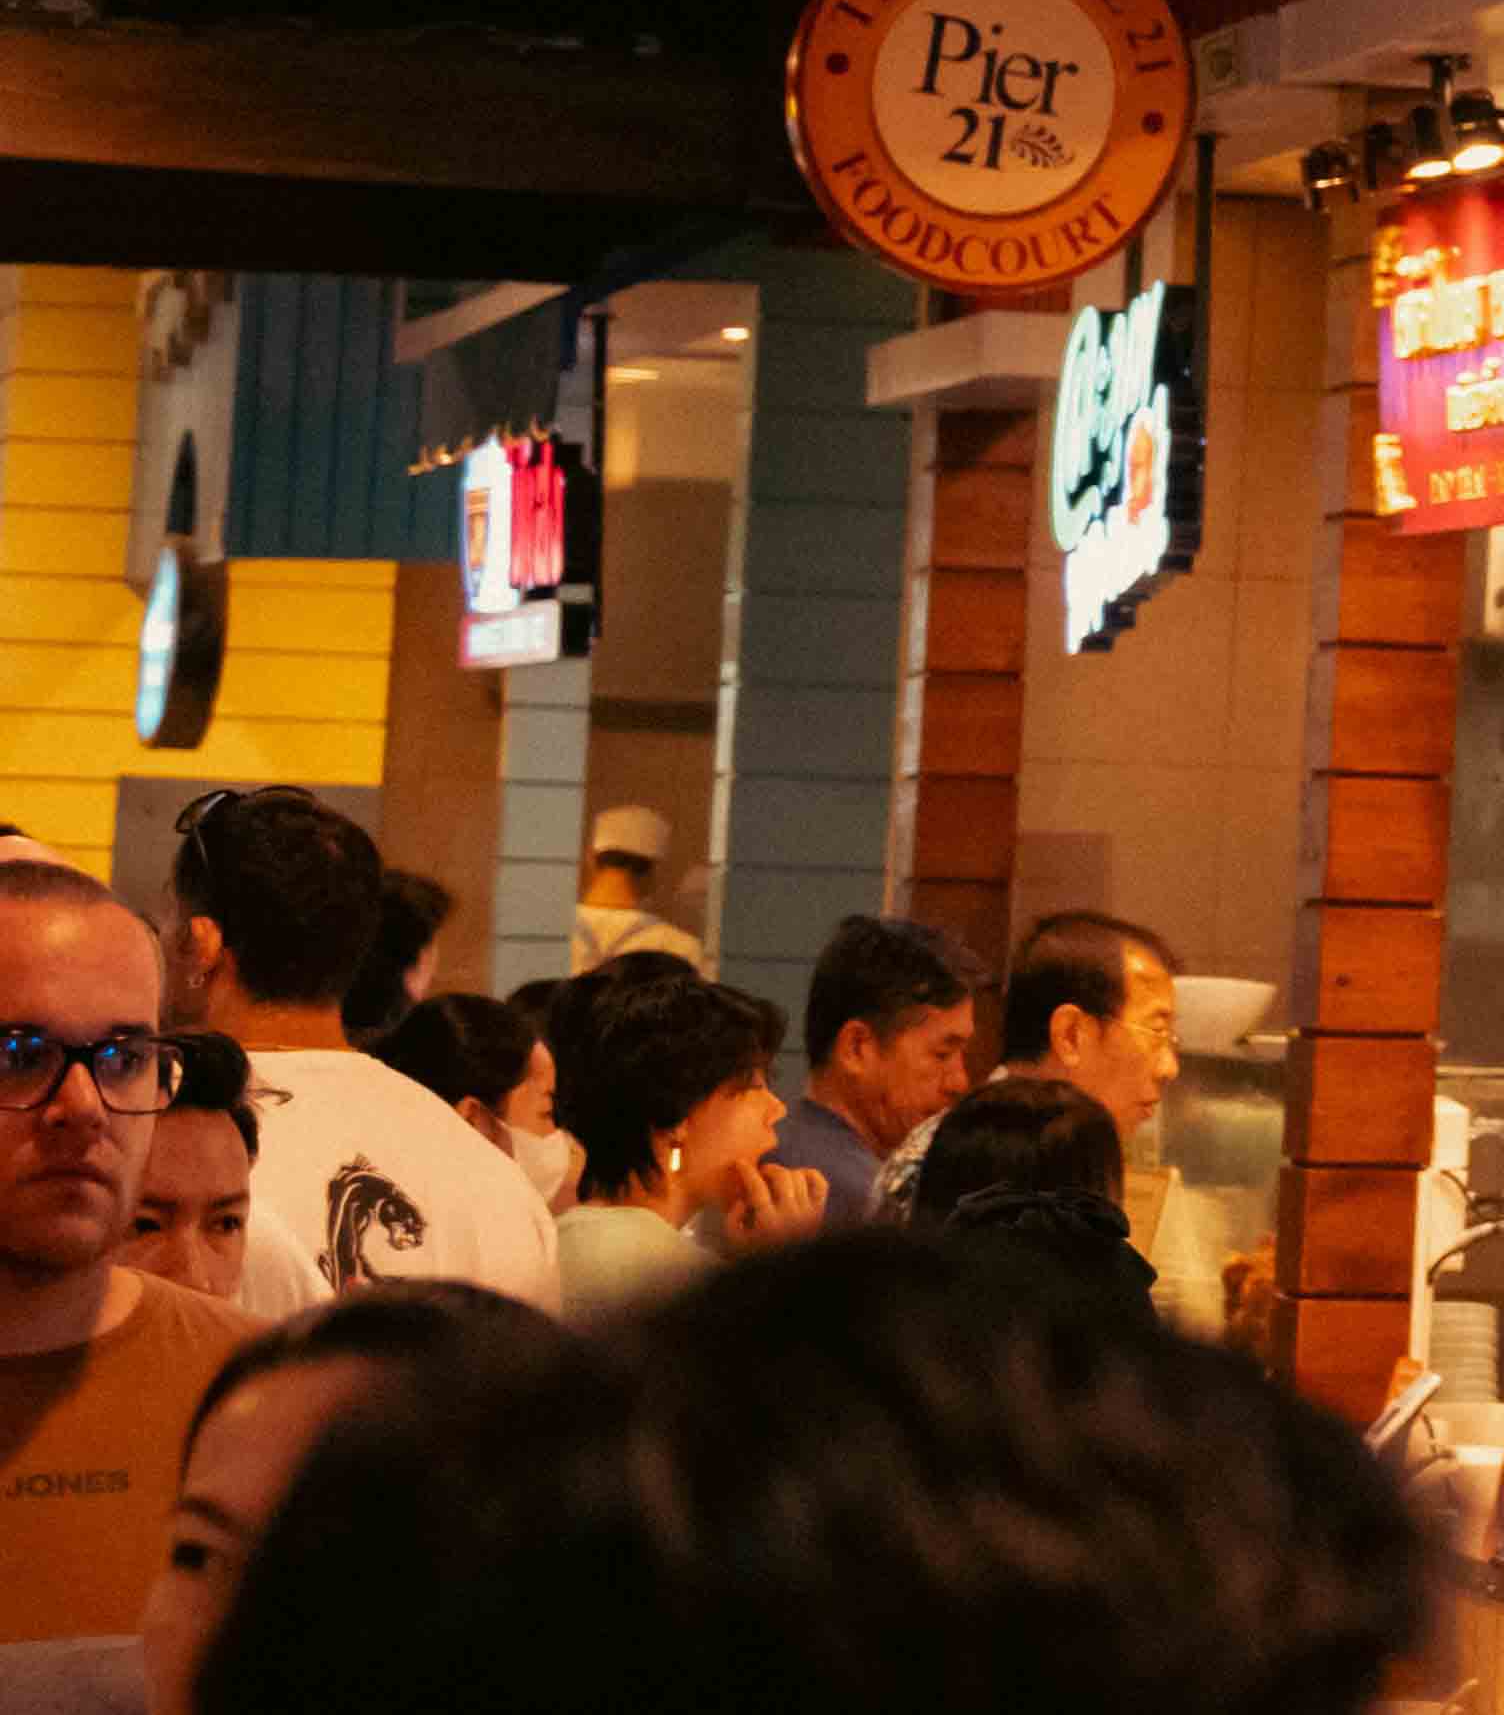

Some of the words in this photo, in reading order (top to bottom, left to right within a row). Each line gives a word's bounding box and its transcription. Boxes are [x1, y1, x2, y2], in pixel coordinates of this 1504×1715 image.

[912, 12, 1079, 116] Pier
[940, 107, 1006, 171] 21
[833, 152, 1124, 275] FOODCOURT
